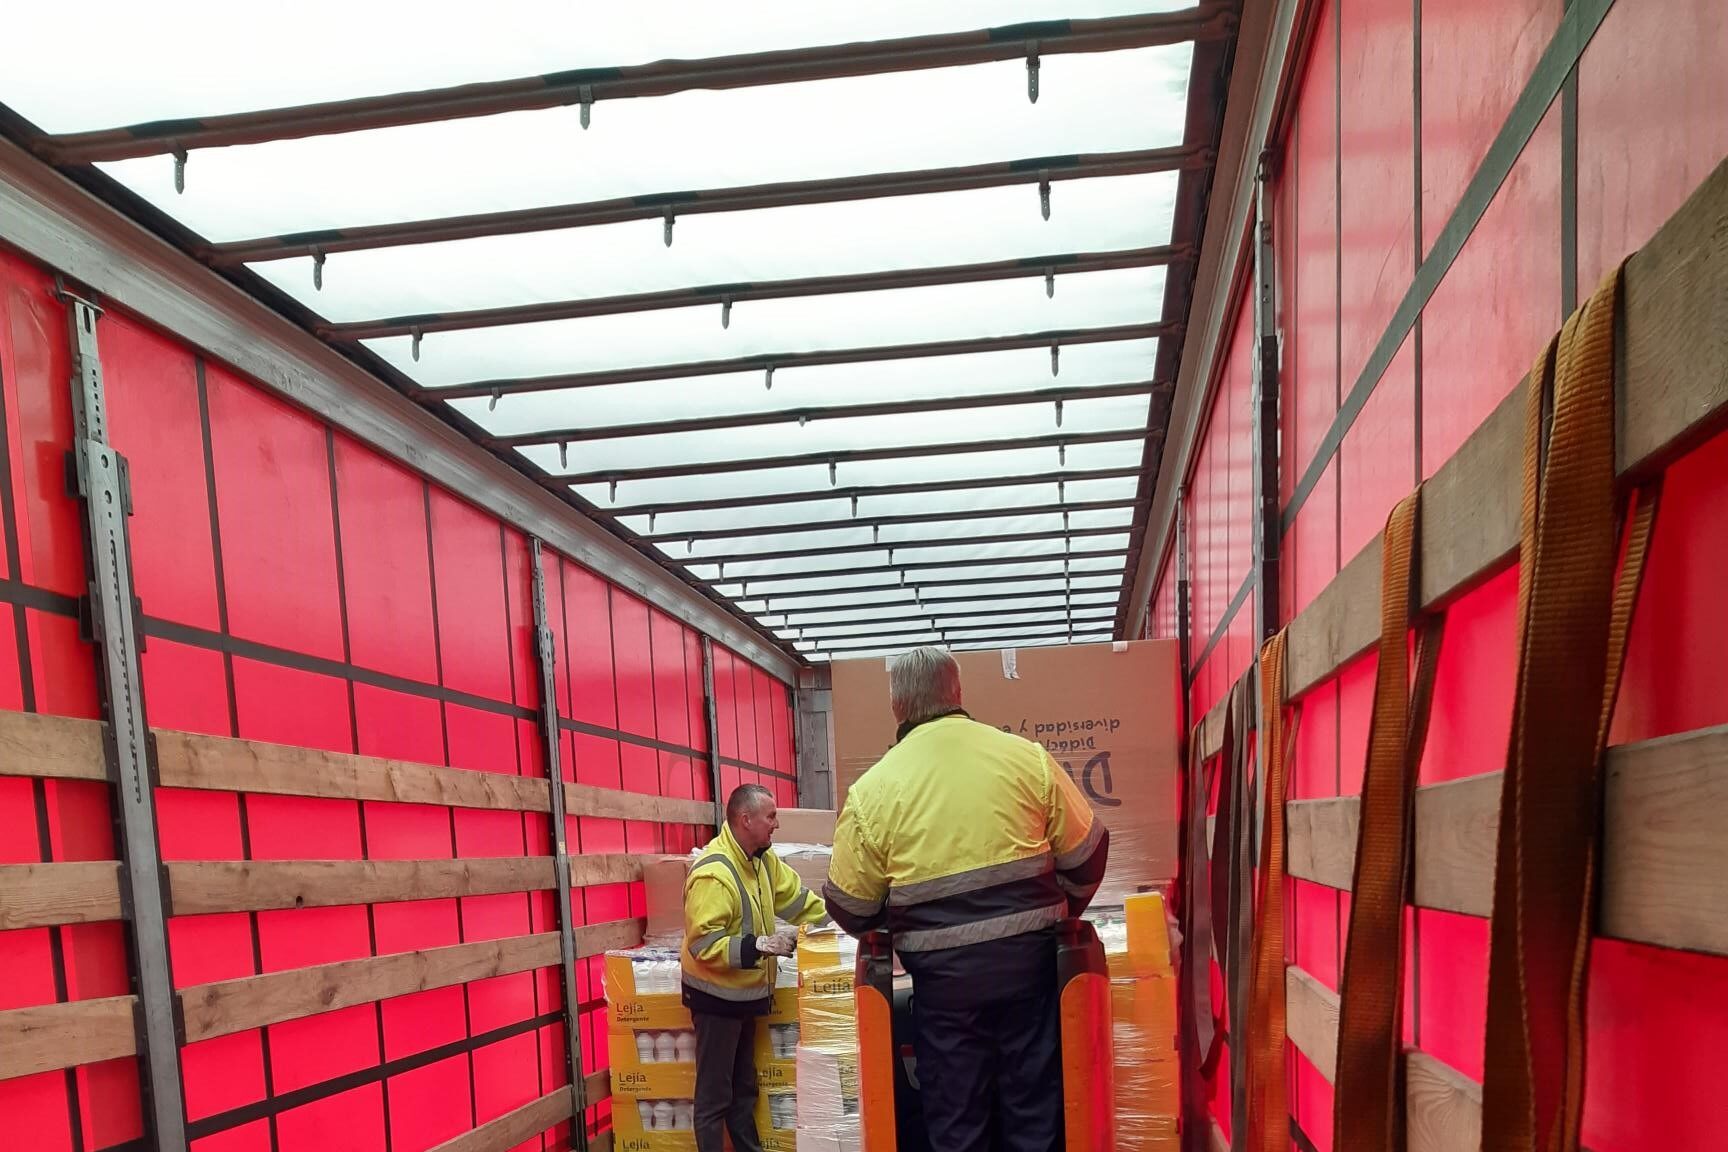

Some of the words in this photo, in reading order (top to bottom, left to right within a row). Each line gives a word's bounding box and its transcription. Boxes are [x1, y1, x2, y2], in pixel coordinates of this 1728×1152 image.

[1034, 718, 1120, 738] diversidad
[814, 978, 851, 995] Lejía
[616, 1002, 644, 1014] Lejía
[618, 1072, 647, 1084] Lejía
[622, 1138, 650, 1151] Lejía
